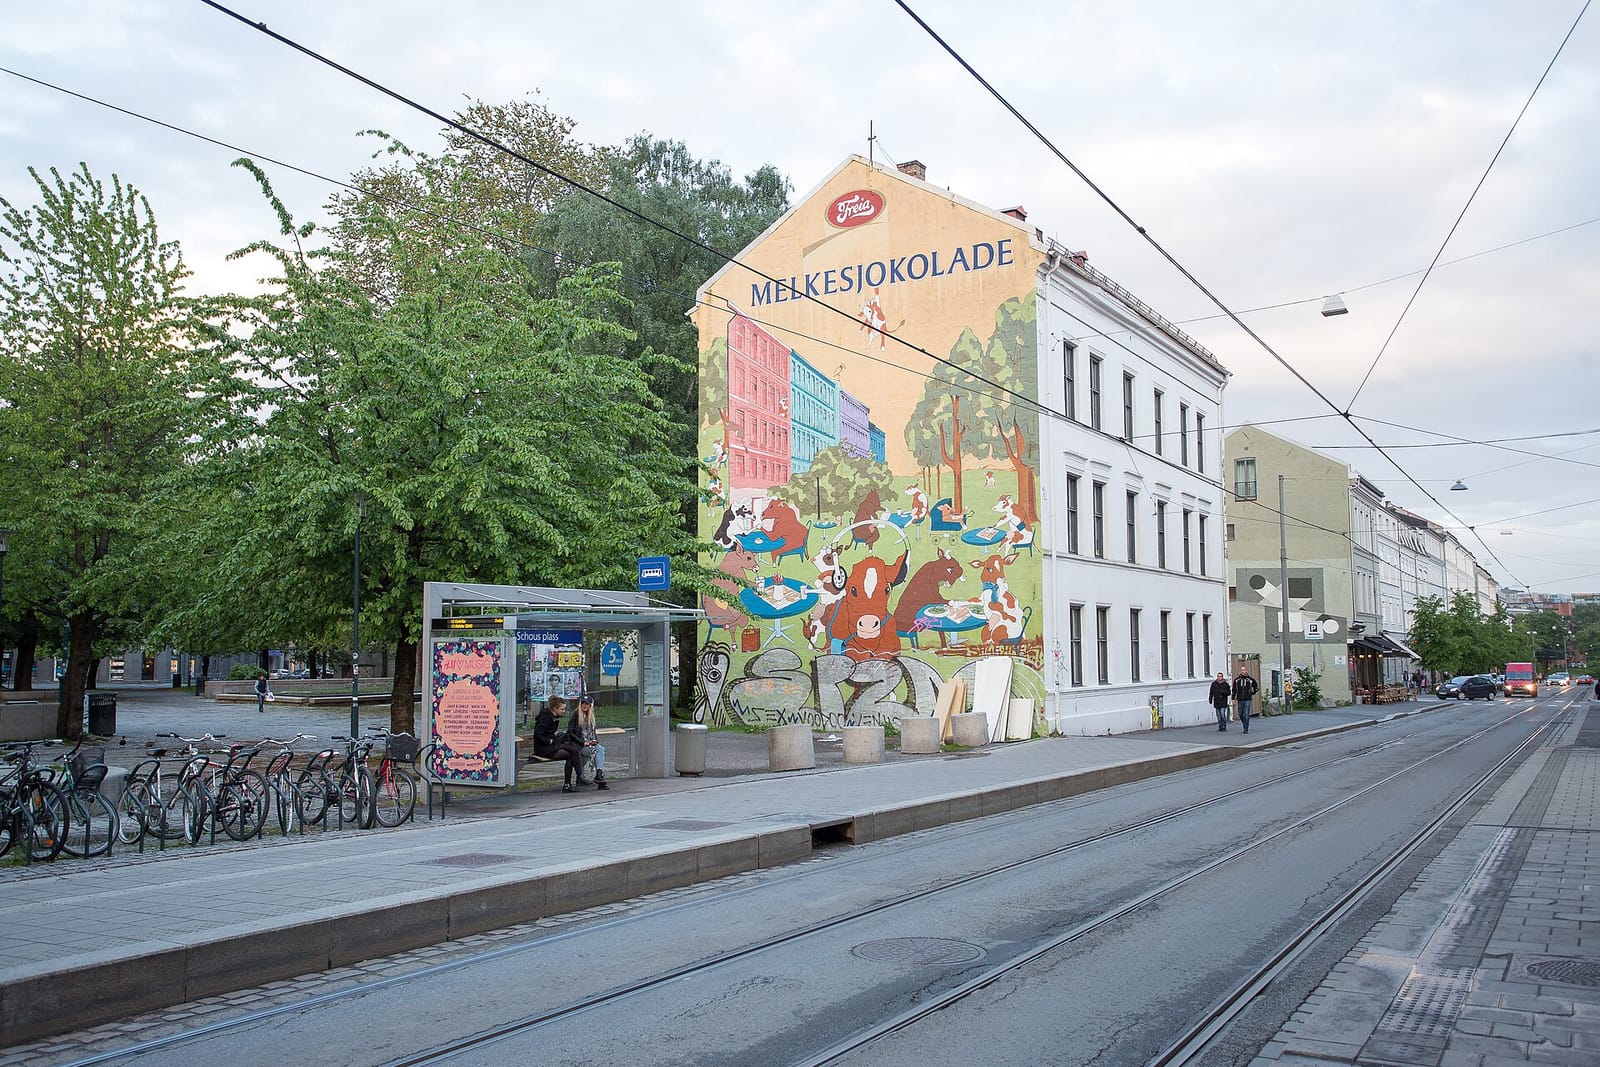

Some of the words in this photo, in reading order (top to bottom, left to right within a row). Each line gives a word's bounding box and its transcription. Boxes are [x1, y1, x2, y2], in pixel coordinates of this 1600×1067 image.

[836, 194, 875, 223] Freia
[751, 238, 1014, 308] MELKESJOKOLADE
[516, 631, 541, 641] Schous
[542, 631, 559, 642] plass
[608, 647, 617, 663] 5
[748, 708, 788, 725] SEX
